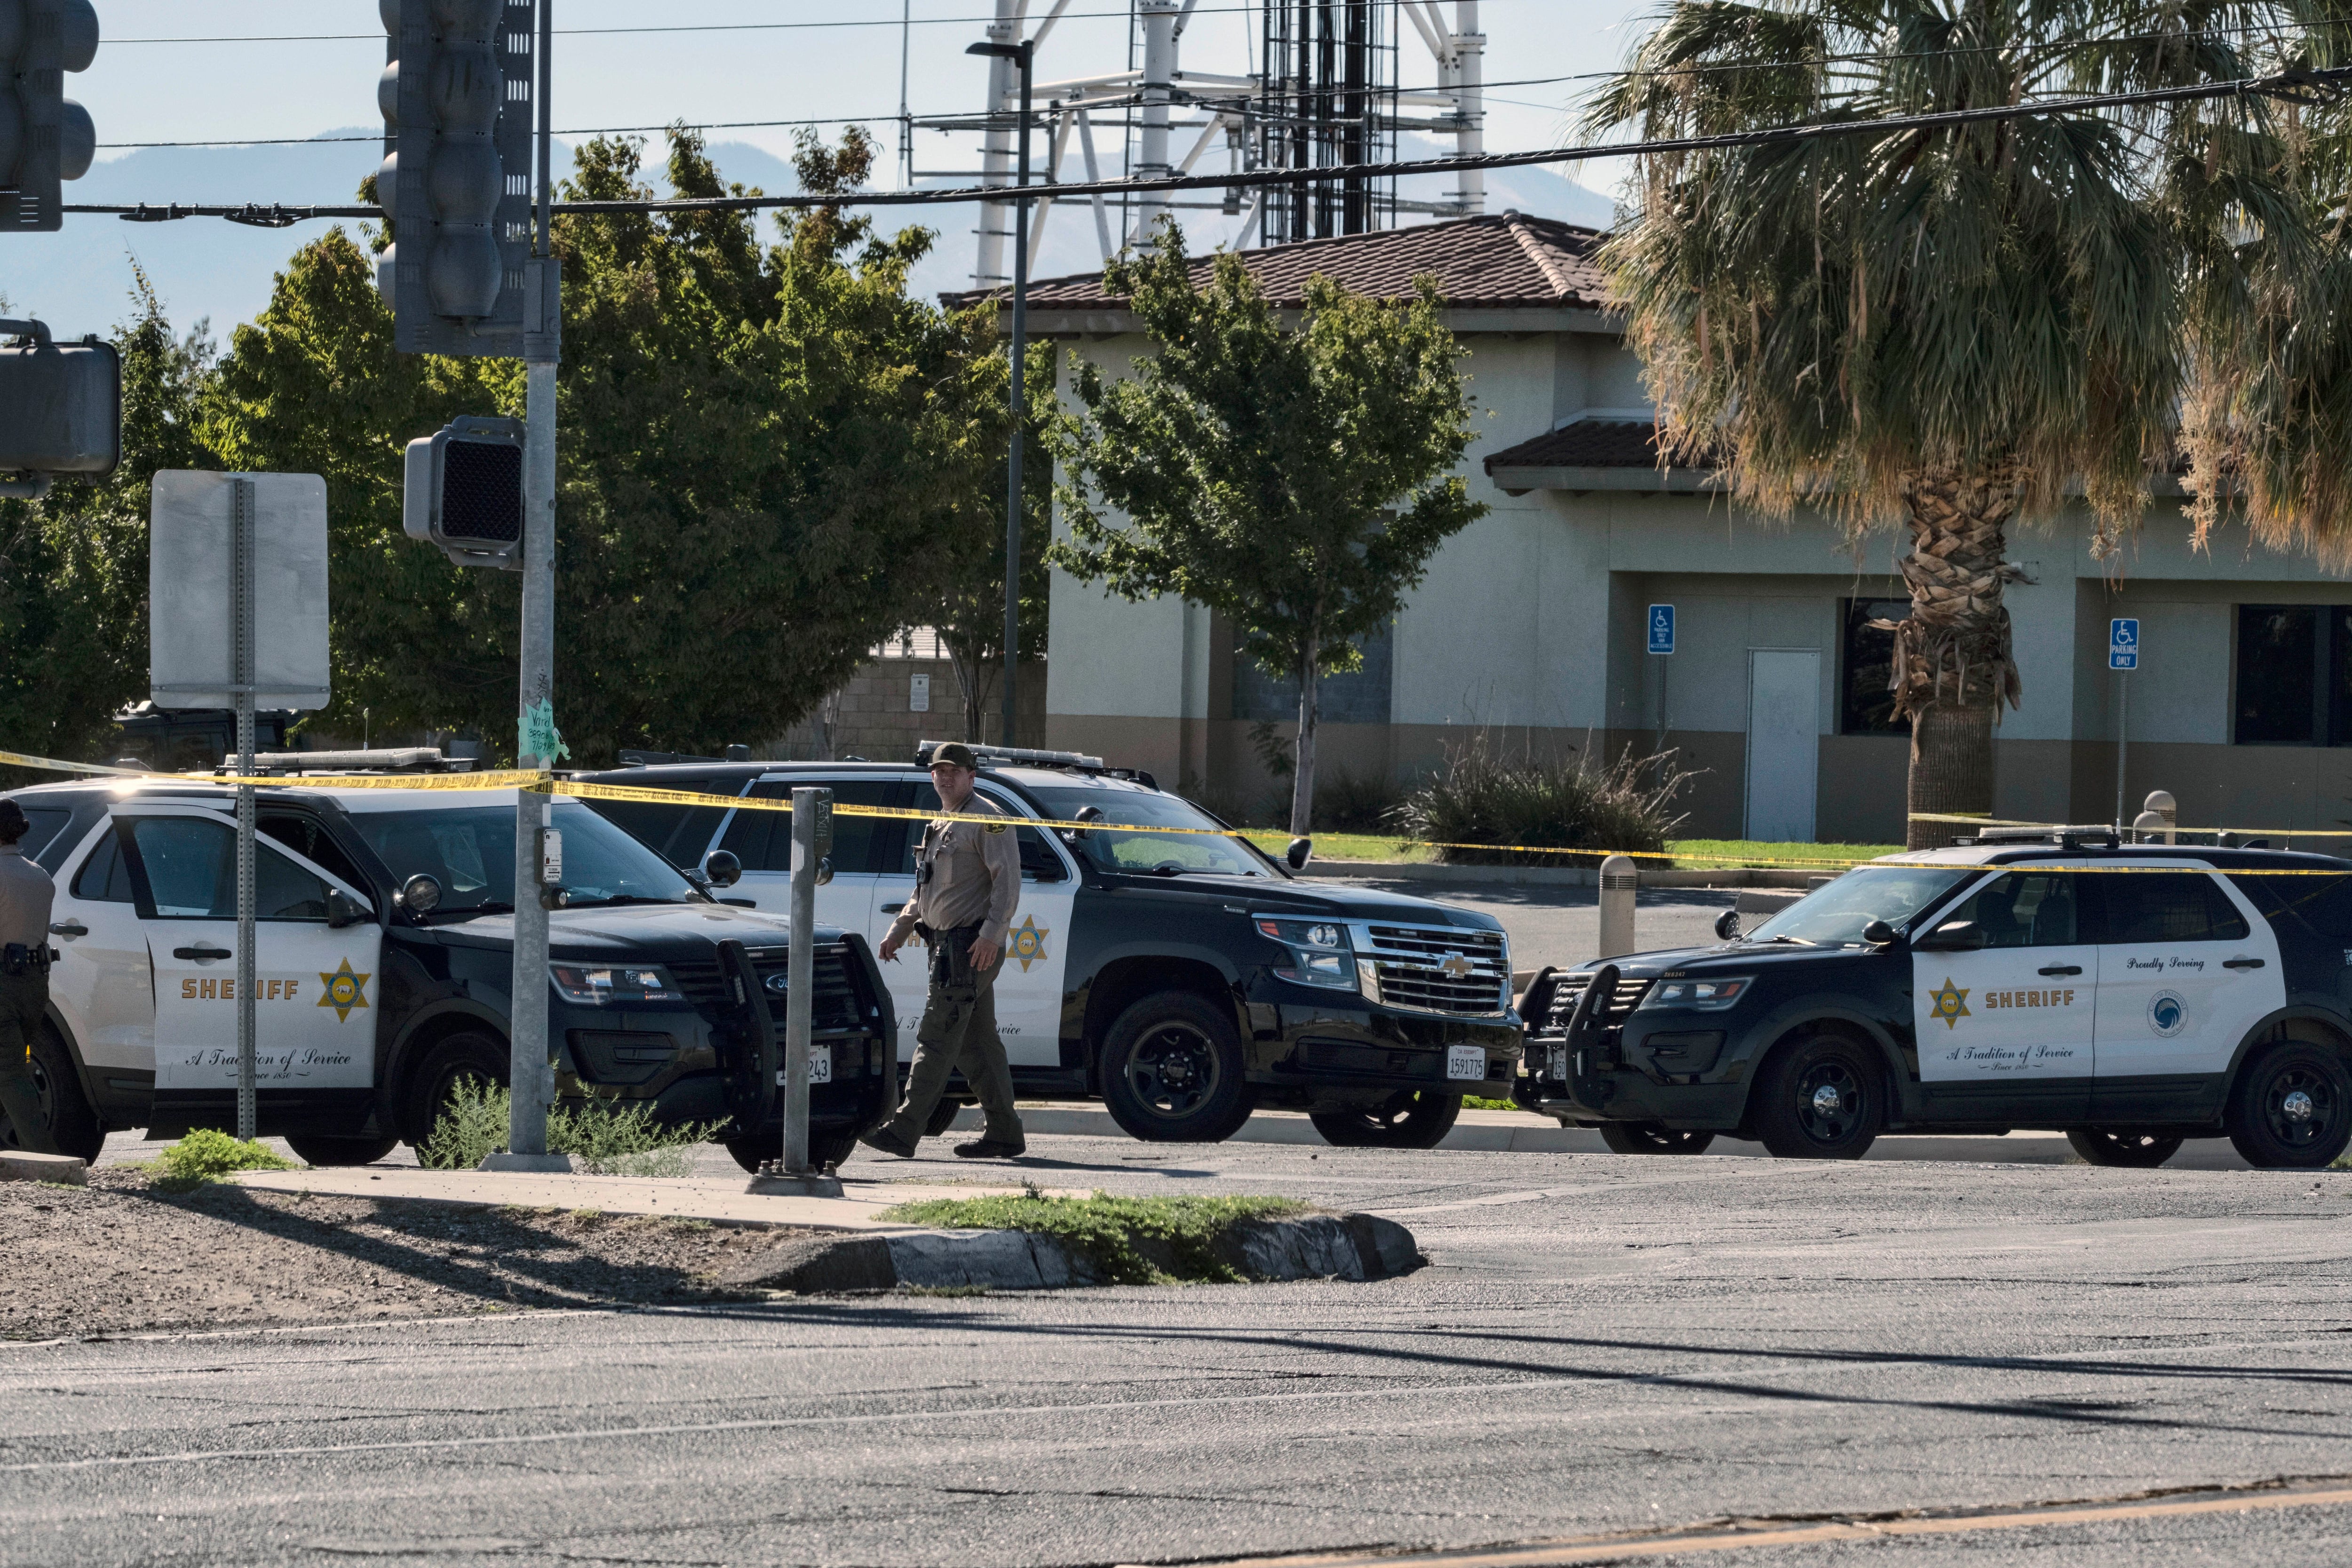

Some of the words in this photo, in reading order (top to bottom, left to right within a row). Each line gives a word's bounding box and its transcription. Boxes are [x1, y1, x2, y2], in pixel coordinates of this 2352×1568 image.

[2111, 644, 2136, 654] PARKING
[2116, 655, 2131, 666] ONLY
[531, 711, 550, 727] Yard
[2127, 957, 2164, 972] Proudly
[2169, 956, 2205, 971] Serving
[182, 979, 299, 1000] SHEIFF
[1986, 989, 2074, 1008] SHERIFF
[185, 1050, 204, 1066] A
[280, 1049, 297, 1071] of
[301, 1048, 351, 1065] Service
[1947, 1047, 1961, 1060] A
[1964, 1046, 2015, 1059] Tradition
[2019, 1046, 2032, 1064] of
[2035, 1045, 2074, 1058] Service
[1450, 1058, 1483, 1075] 1591775
